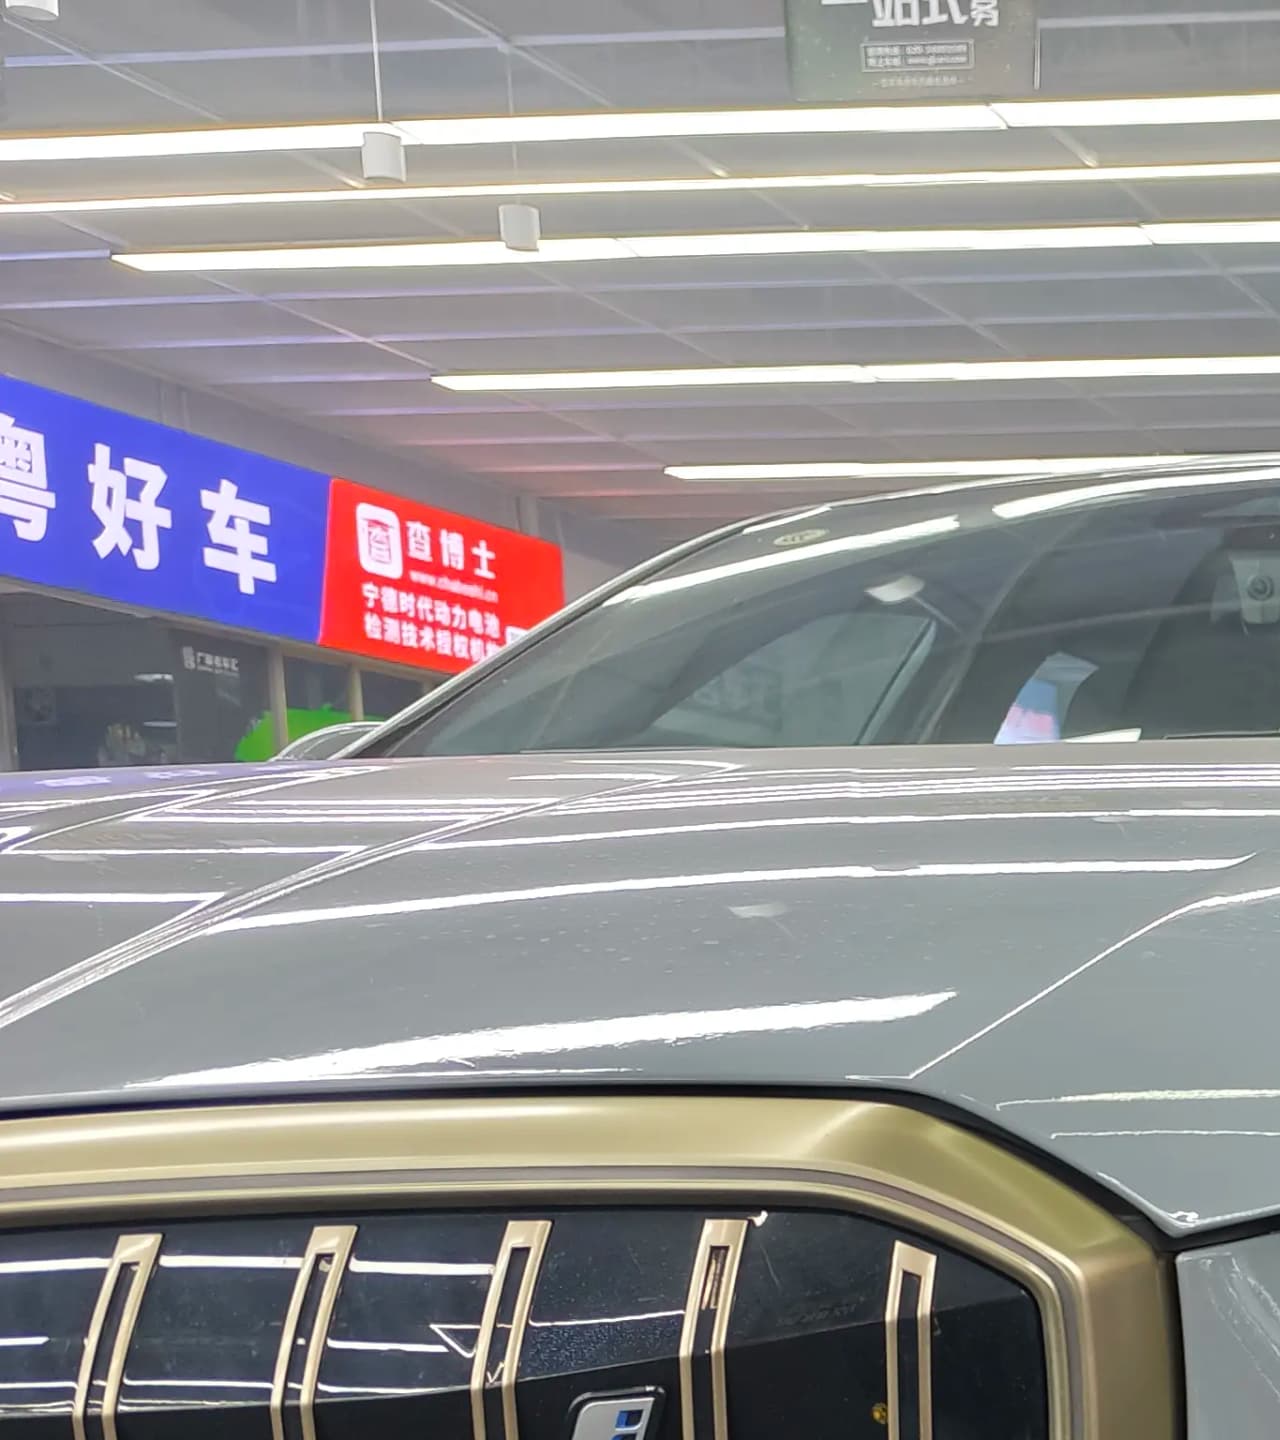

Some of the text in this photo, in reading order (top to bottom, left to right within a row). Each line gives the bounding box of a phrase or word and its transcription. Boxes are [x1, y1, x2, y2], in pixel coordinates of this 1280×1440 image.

[406, 520, 496, 579] 查博士
[362, 582, 501, 639] 宁德时代动力电池
